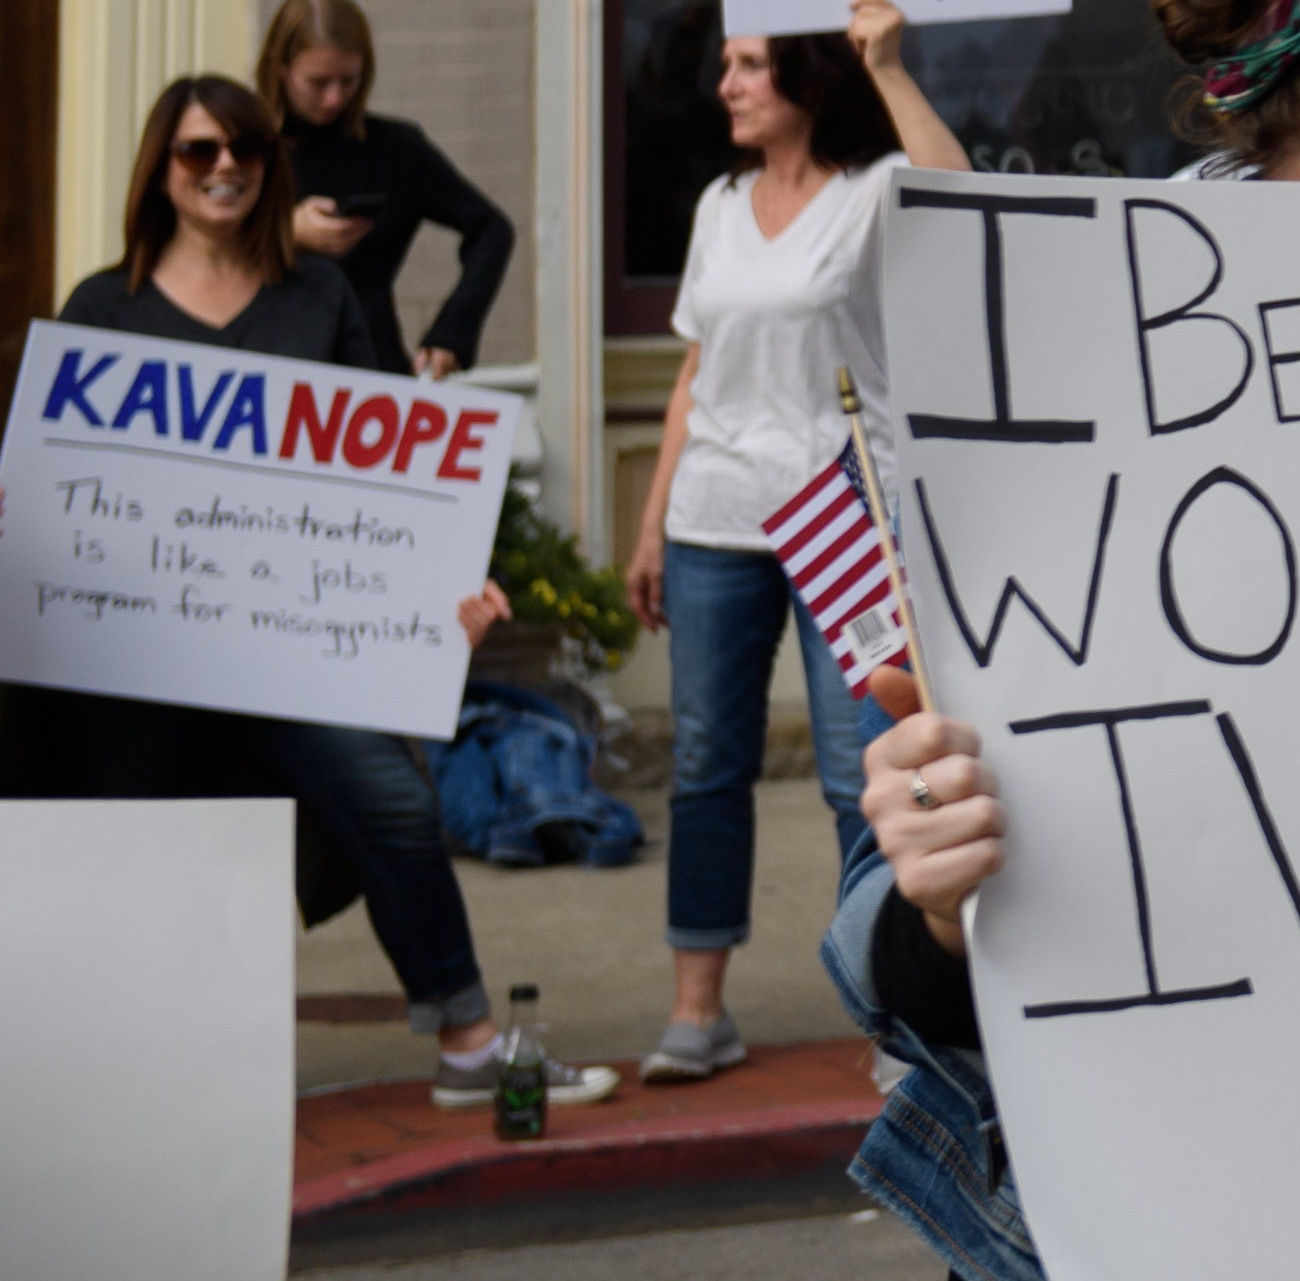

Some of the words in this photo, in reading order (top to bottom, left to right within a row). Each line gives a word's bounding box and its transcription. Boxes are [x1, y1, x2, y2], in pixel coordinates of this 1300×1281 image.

[899, 188, 1097, 443] I
[42, 349, 499, 482] KAVANOPE
[56, 475, 144, 521] This
[174, 495, 416, 550] administration
[34, 580, 158, 619] program
[172, 583, 232, 622] for
[73, 529, 105, 564] is
[151, 536, 226, 580] like
[250, 559, 280, 584] a
[299, 558, 388, 607] jobs
[1009, 699, 1254, 1020] I
